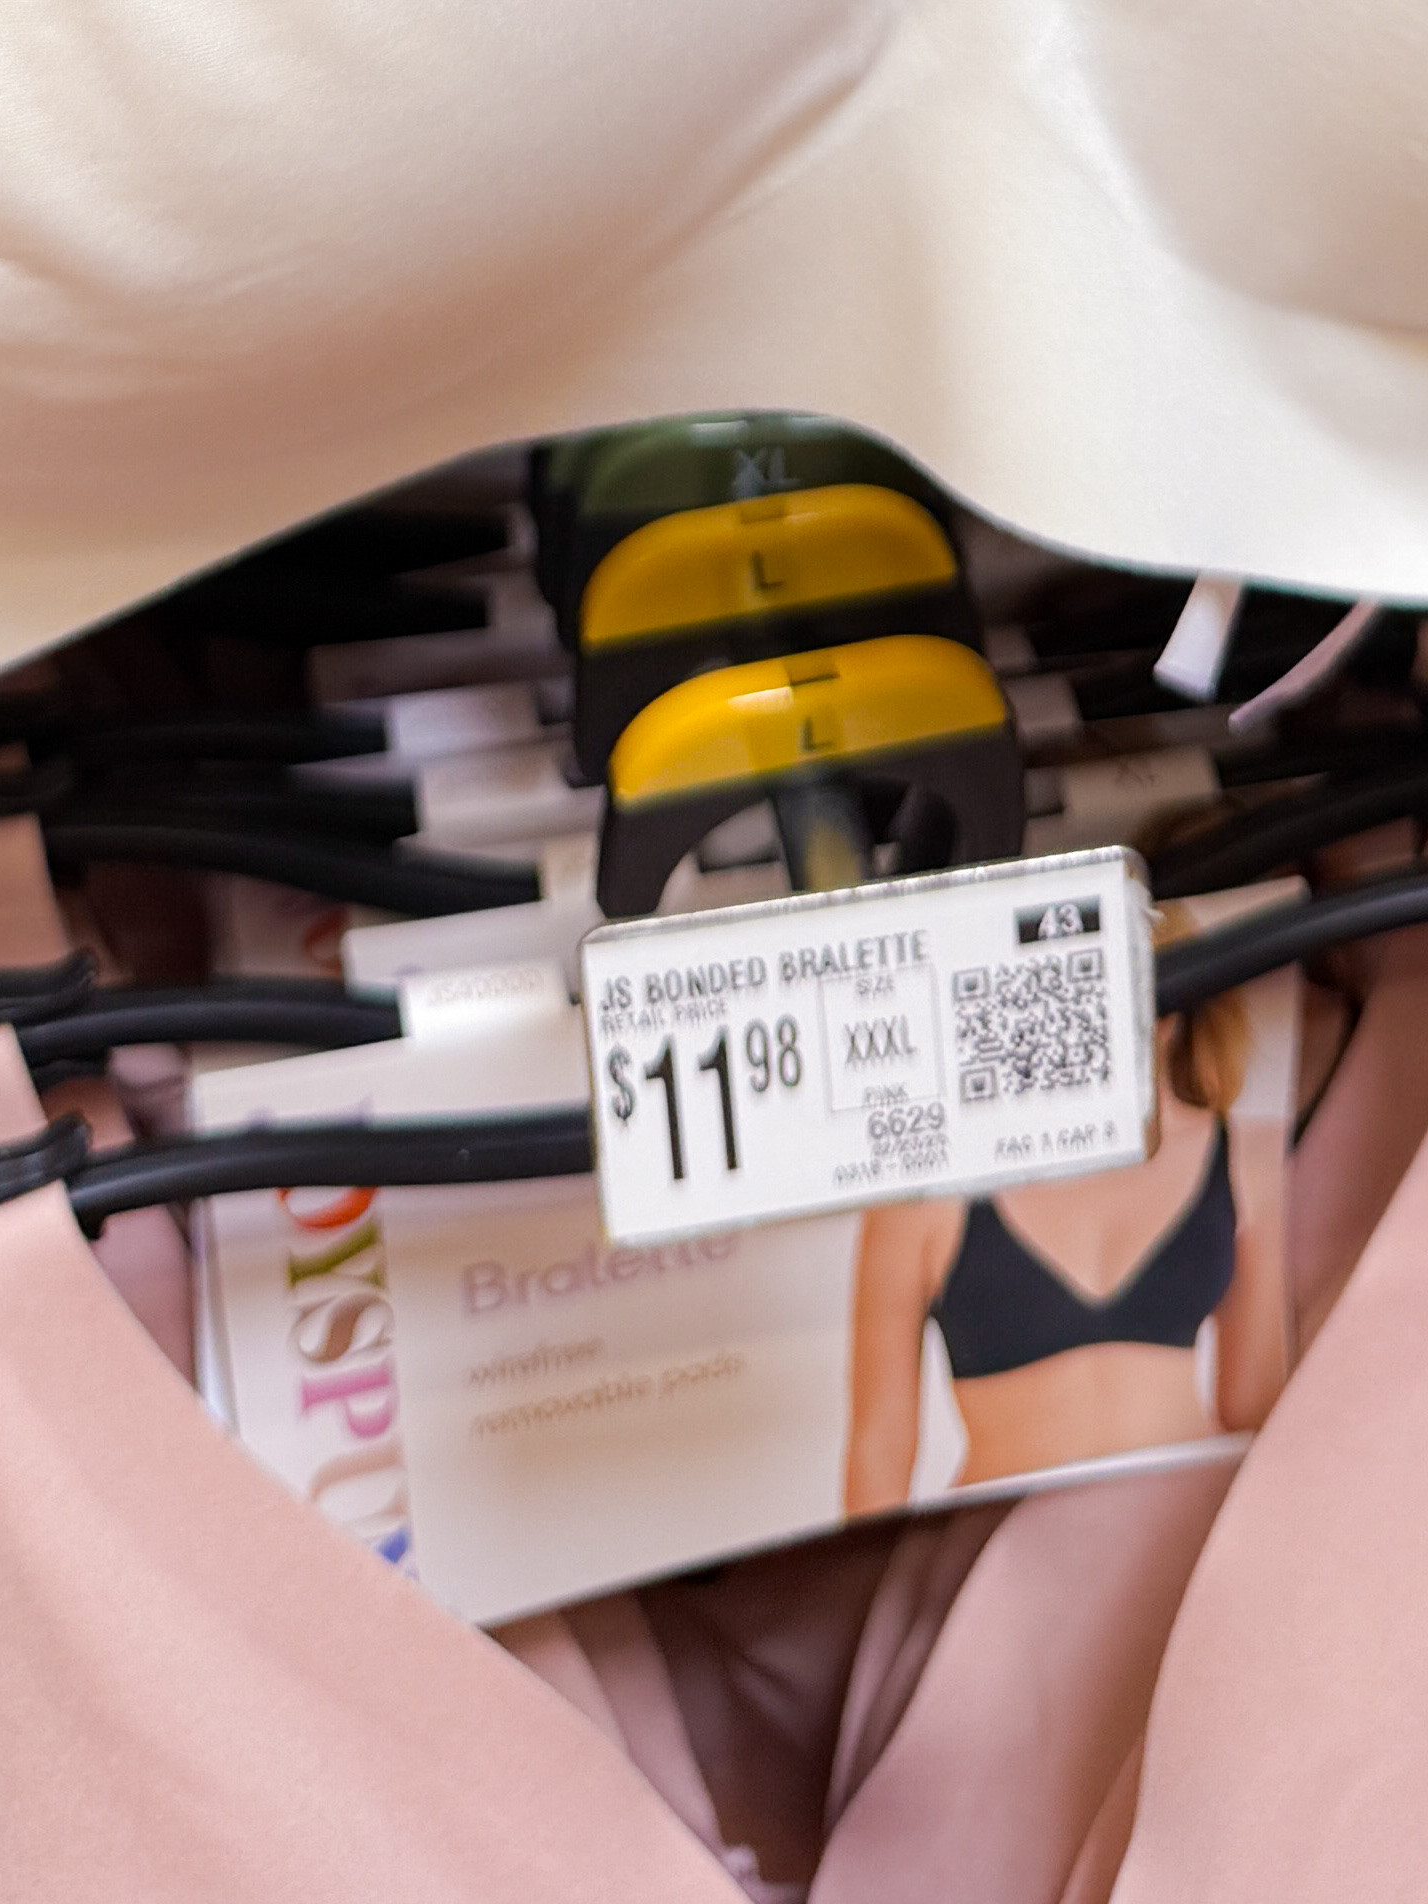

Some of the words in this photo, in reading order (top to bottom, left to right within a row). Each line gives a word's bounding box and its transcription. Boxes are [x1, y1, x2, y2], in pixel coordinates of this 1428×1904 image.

[601, 975, 633, 1011] JS
[644, 956, 767, 1003] BONDED
[777, 930, 928, 982] BRALETTE
[844, 1013, 917, 1066] XXXL
[867, 1101, 947, 1141] 6629
